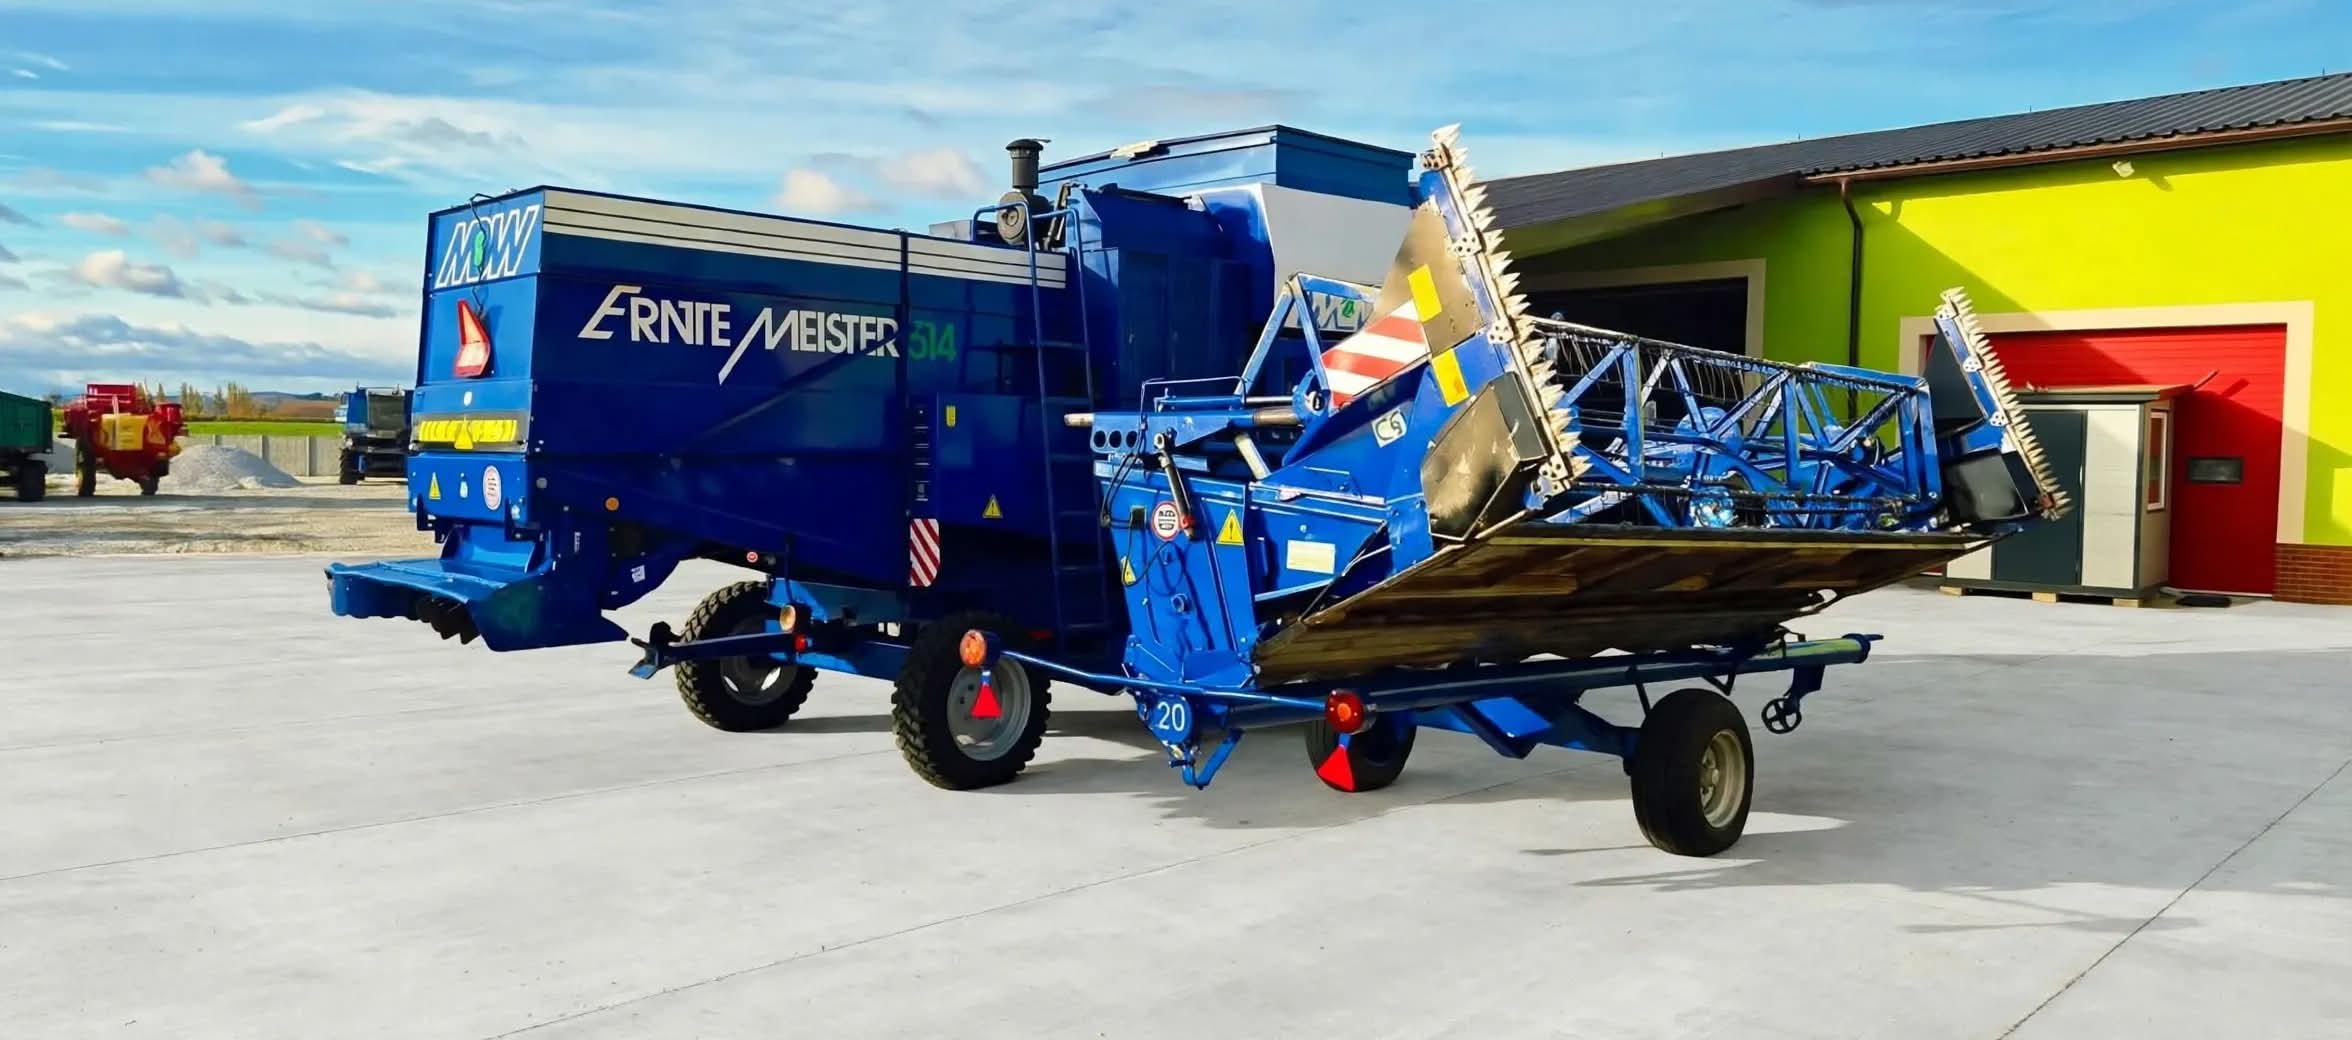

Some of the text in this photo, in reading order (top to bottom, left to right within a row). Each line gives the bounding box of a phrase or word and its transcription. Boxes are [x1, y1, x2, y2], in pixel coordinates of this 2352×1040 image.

[577, 285, 731, 347] ERNTE
[718, 307, 900, 386] MEISTER
[1157, 701, 1186, 732] 20
